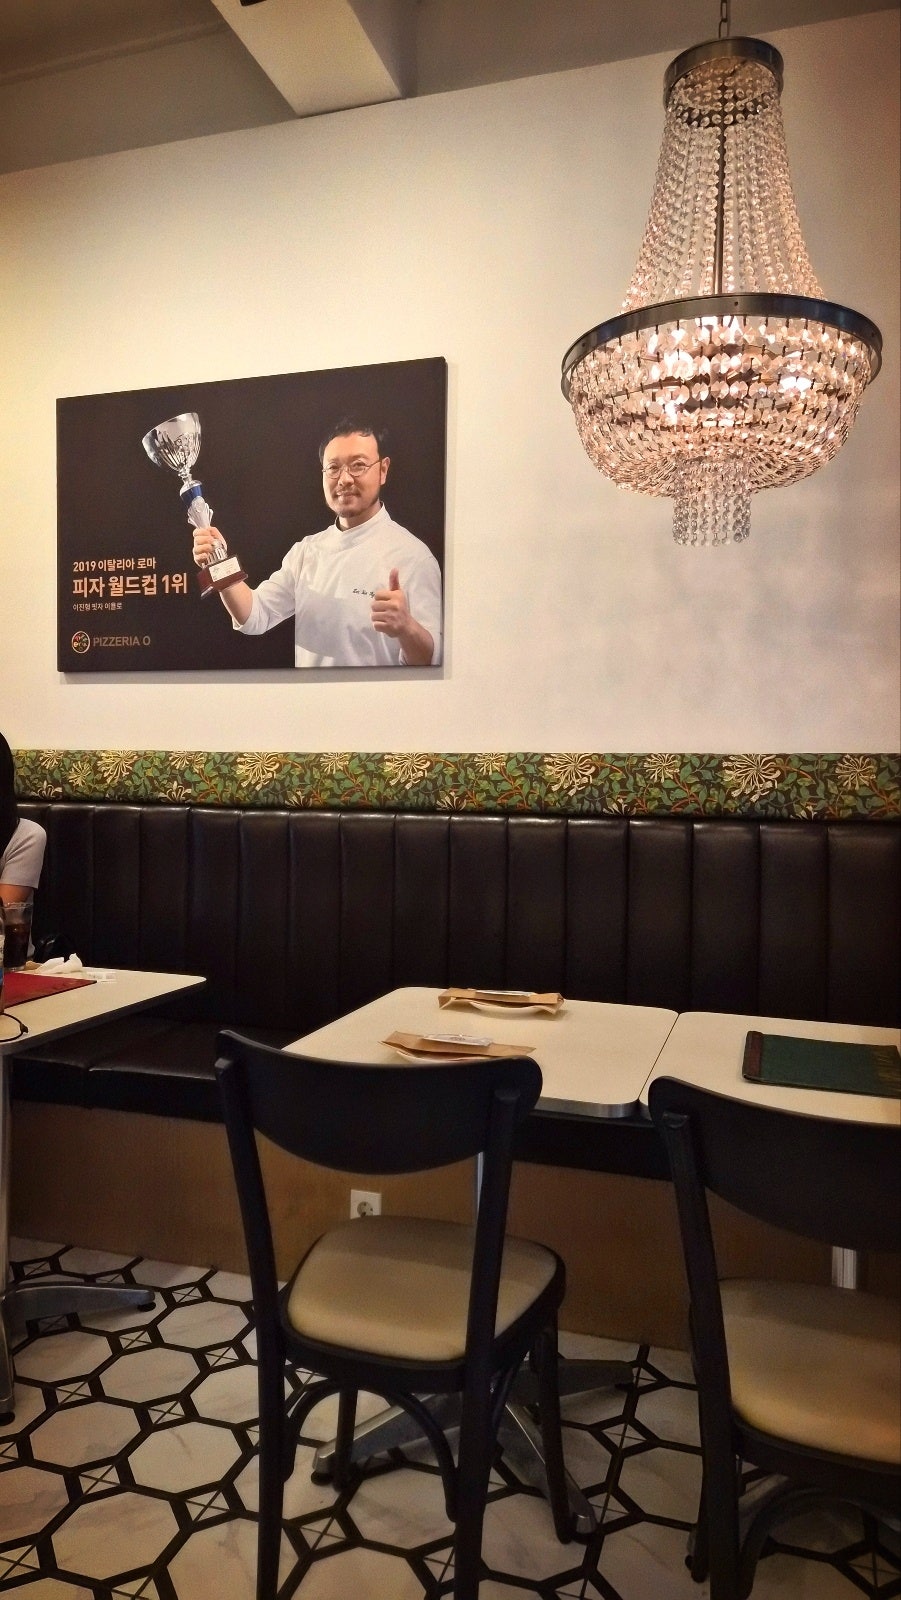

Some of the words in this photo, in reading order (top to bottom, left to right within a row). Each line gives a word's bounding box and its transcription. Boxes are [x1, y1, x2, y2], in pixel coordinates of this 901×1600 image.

[73, 561, 96, 572] 2019
[98, 558, 135, 572] 이탈리아
[137, 557, 157, 569] 로마
[72, 577, 105, 598] 피자
[108, 574, 157, 597] 월드컵
[161, 573, 187, 594] 1위
[93, 636, 140, 647] PIZZERIA
[142, 635, 151, 646] O
